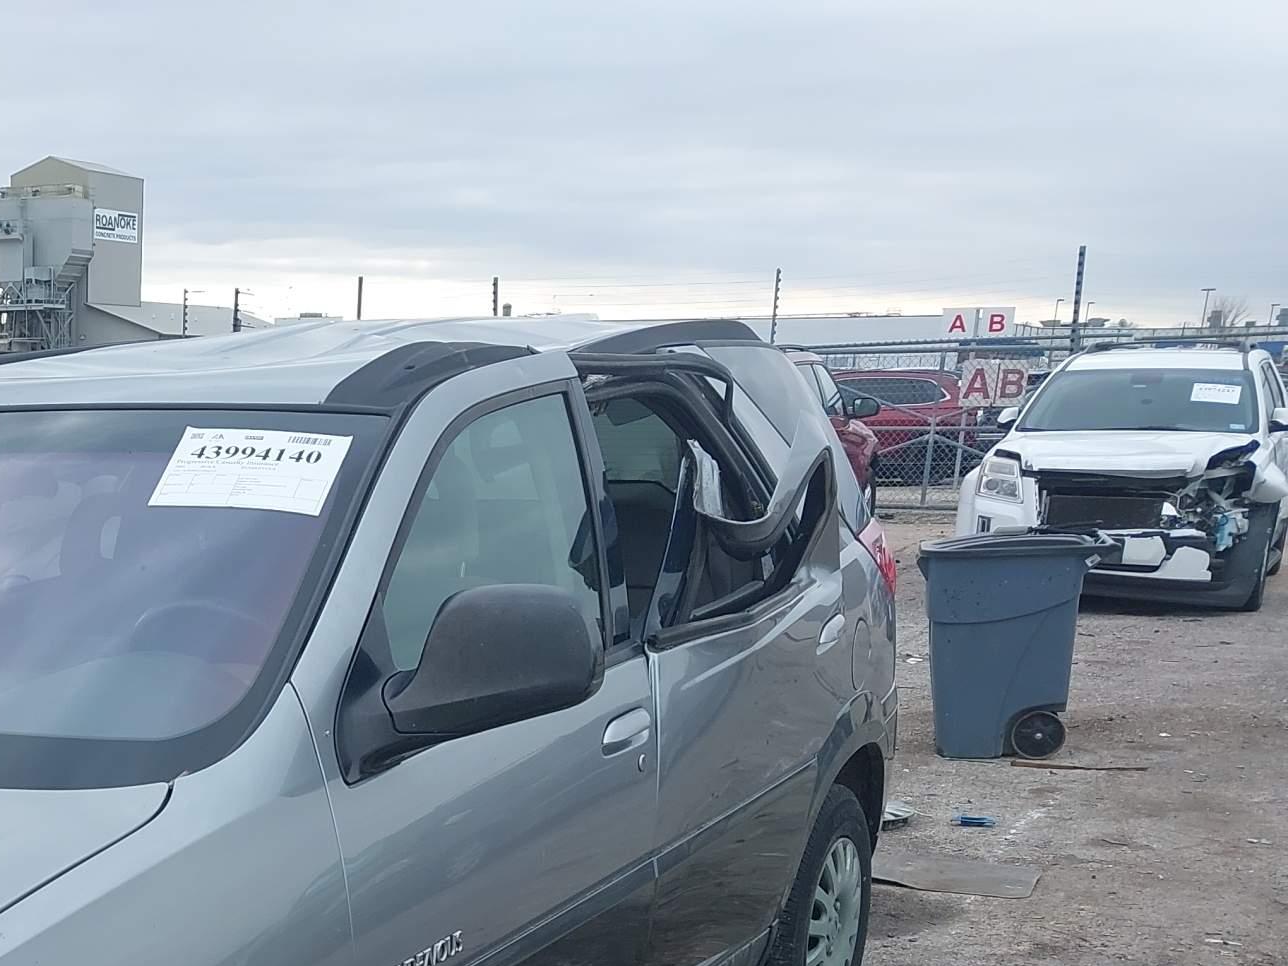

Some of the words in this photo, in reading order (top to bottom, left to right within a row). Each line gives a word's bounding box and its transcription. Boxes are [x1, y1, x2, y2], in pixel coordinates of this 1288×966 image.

[96, 214, 136, 231] ROANOKE
[117, 233, 137, 241] PRODUCTS
[948, 314, 966, 333] A
[989, 314, 1005, 333] B
[963, 368, 990, 399] A
[999, 368, 1025, 399] B
[190, 445, 323, 465] 43994140
